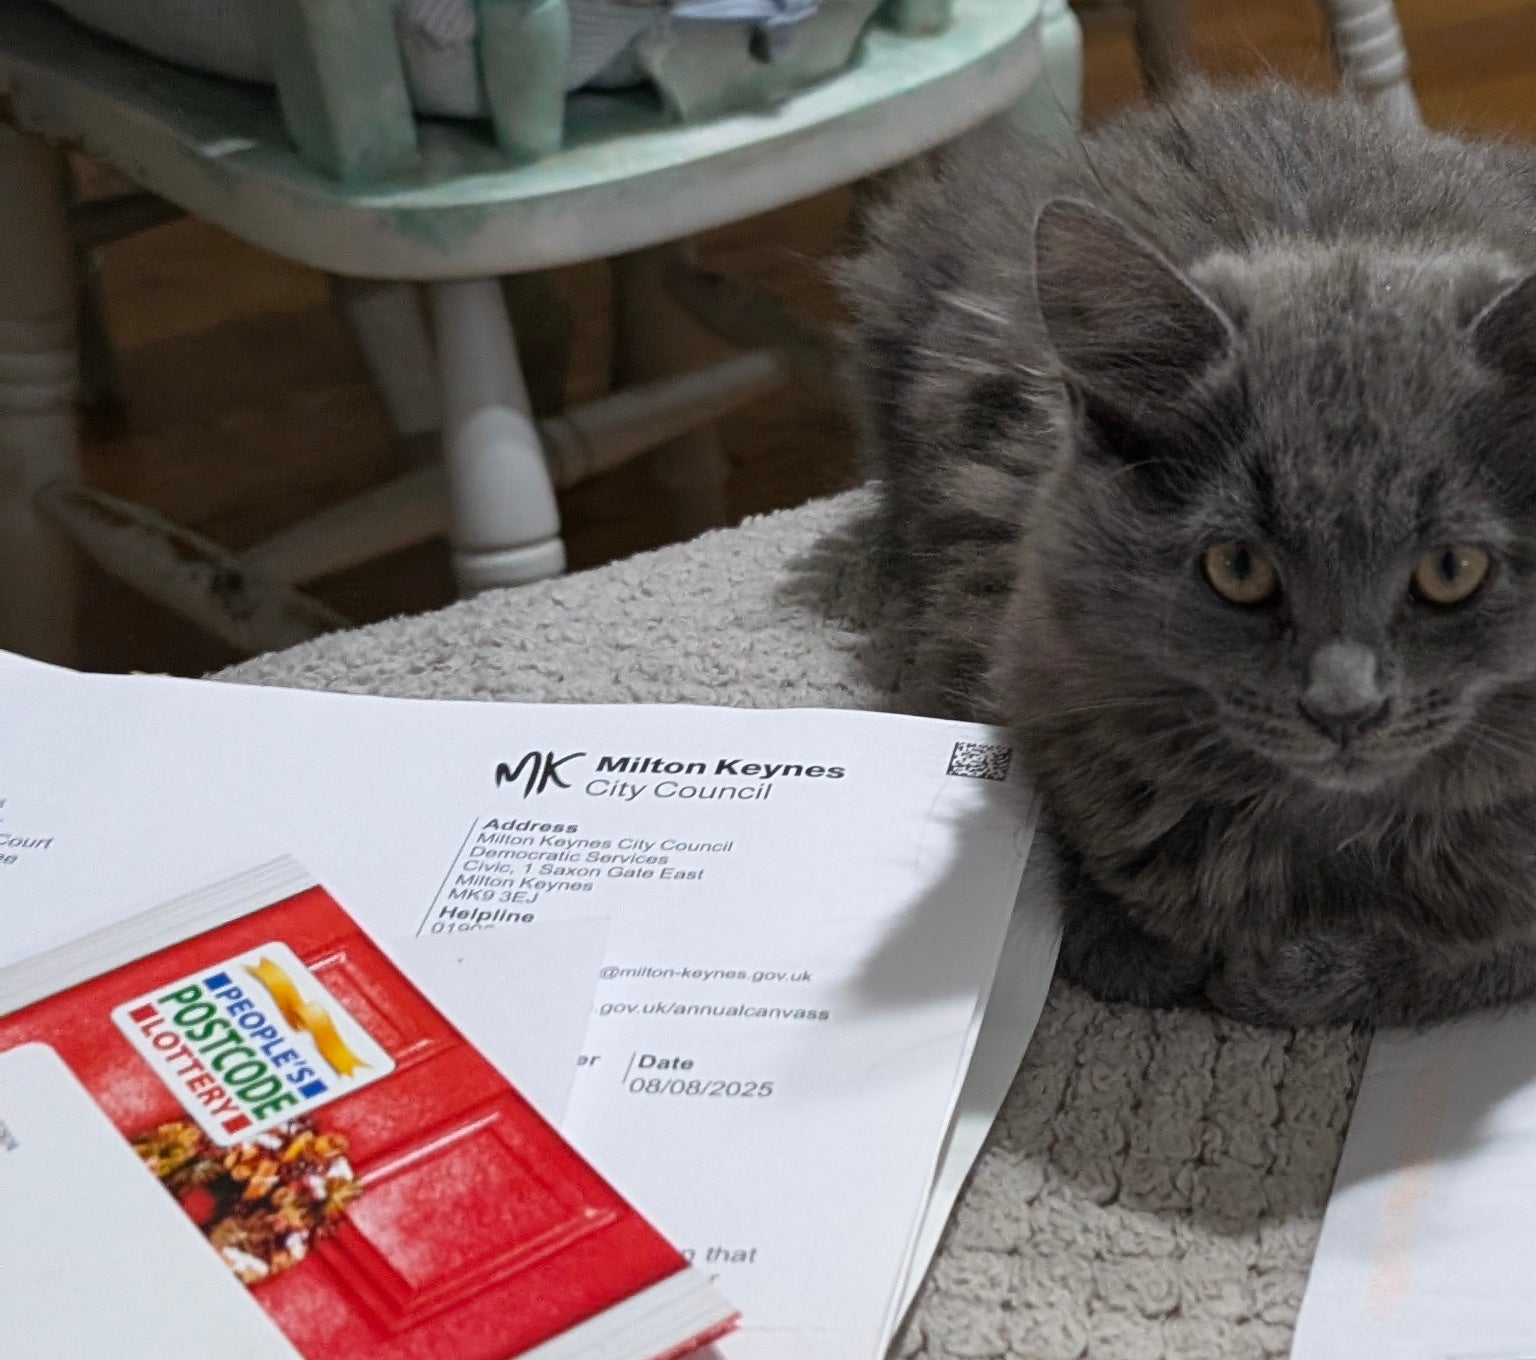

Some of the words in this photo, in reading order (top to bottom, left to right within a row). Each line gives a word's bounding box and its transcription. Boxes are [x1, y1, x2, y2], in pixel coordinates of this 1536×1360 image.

[595, 755, 706, 776] Milton
[713, 758, 847, 781] Keynes
[585, 778, 647, 802] City
[653, 779, 775, 801] Council
[482, 818, 580, 834] Address
[476, 832, 536, 845] Milton
[540, 835, 612, 851] Keynes
[618, 838, 655, 853] City
[660, 839, 735, 853] Council
[469, 846, 580, 862] Democratic
[585, 850, 669, 866] Services
[462, 860, 515, 875] Civic,
[524, 862, 533, 874] 1
[539, 863, 602, 878] Saxon
[615, 866, 655, 880] Gate
[660, 868, 705, 882] East
[455, 874, 515, 888] Milton
[519, 877, 595, 892] Keynes
[448, 888, 496, 902] MK9
[499, 890, 539, 904] 3EJ
[439, 905, 535, 924] Helpline
[214, 984, 318, 1088] PEOPLE'S
[156, 983, 301, 1121] POSTCODE
[637, 1053, 695, 1071] Date
[140, 1014, 241, 1119] LOTTERY
[627, 1077, 776, 1099] 08/08/2025
[705, 1246, 759, 1265] that
